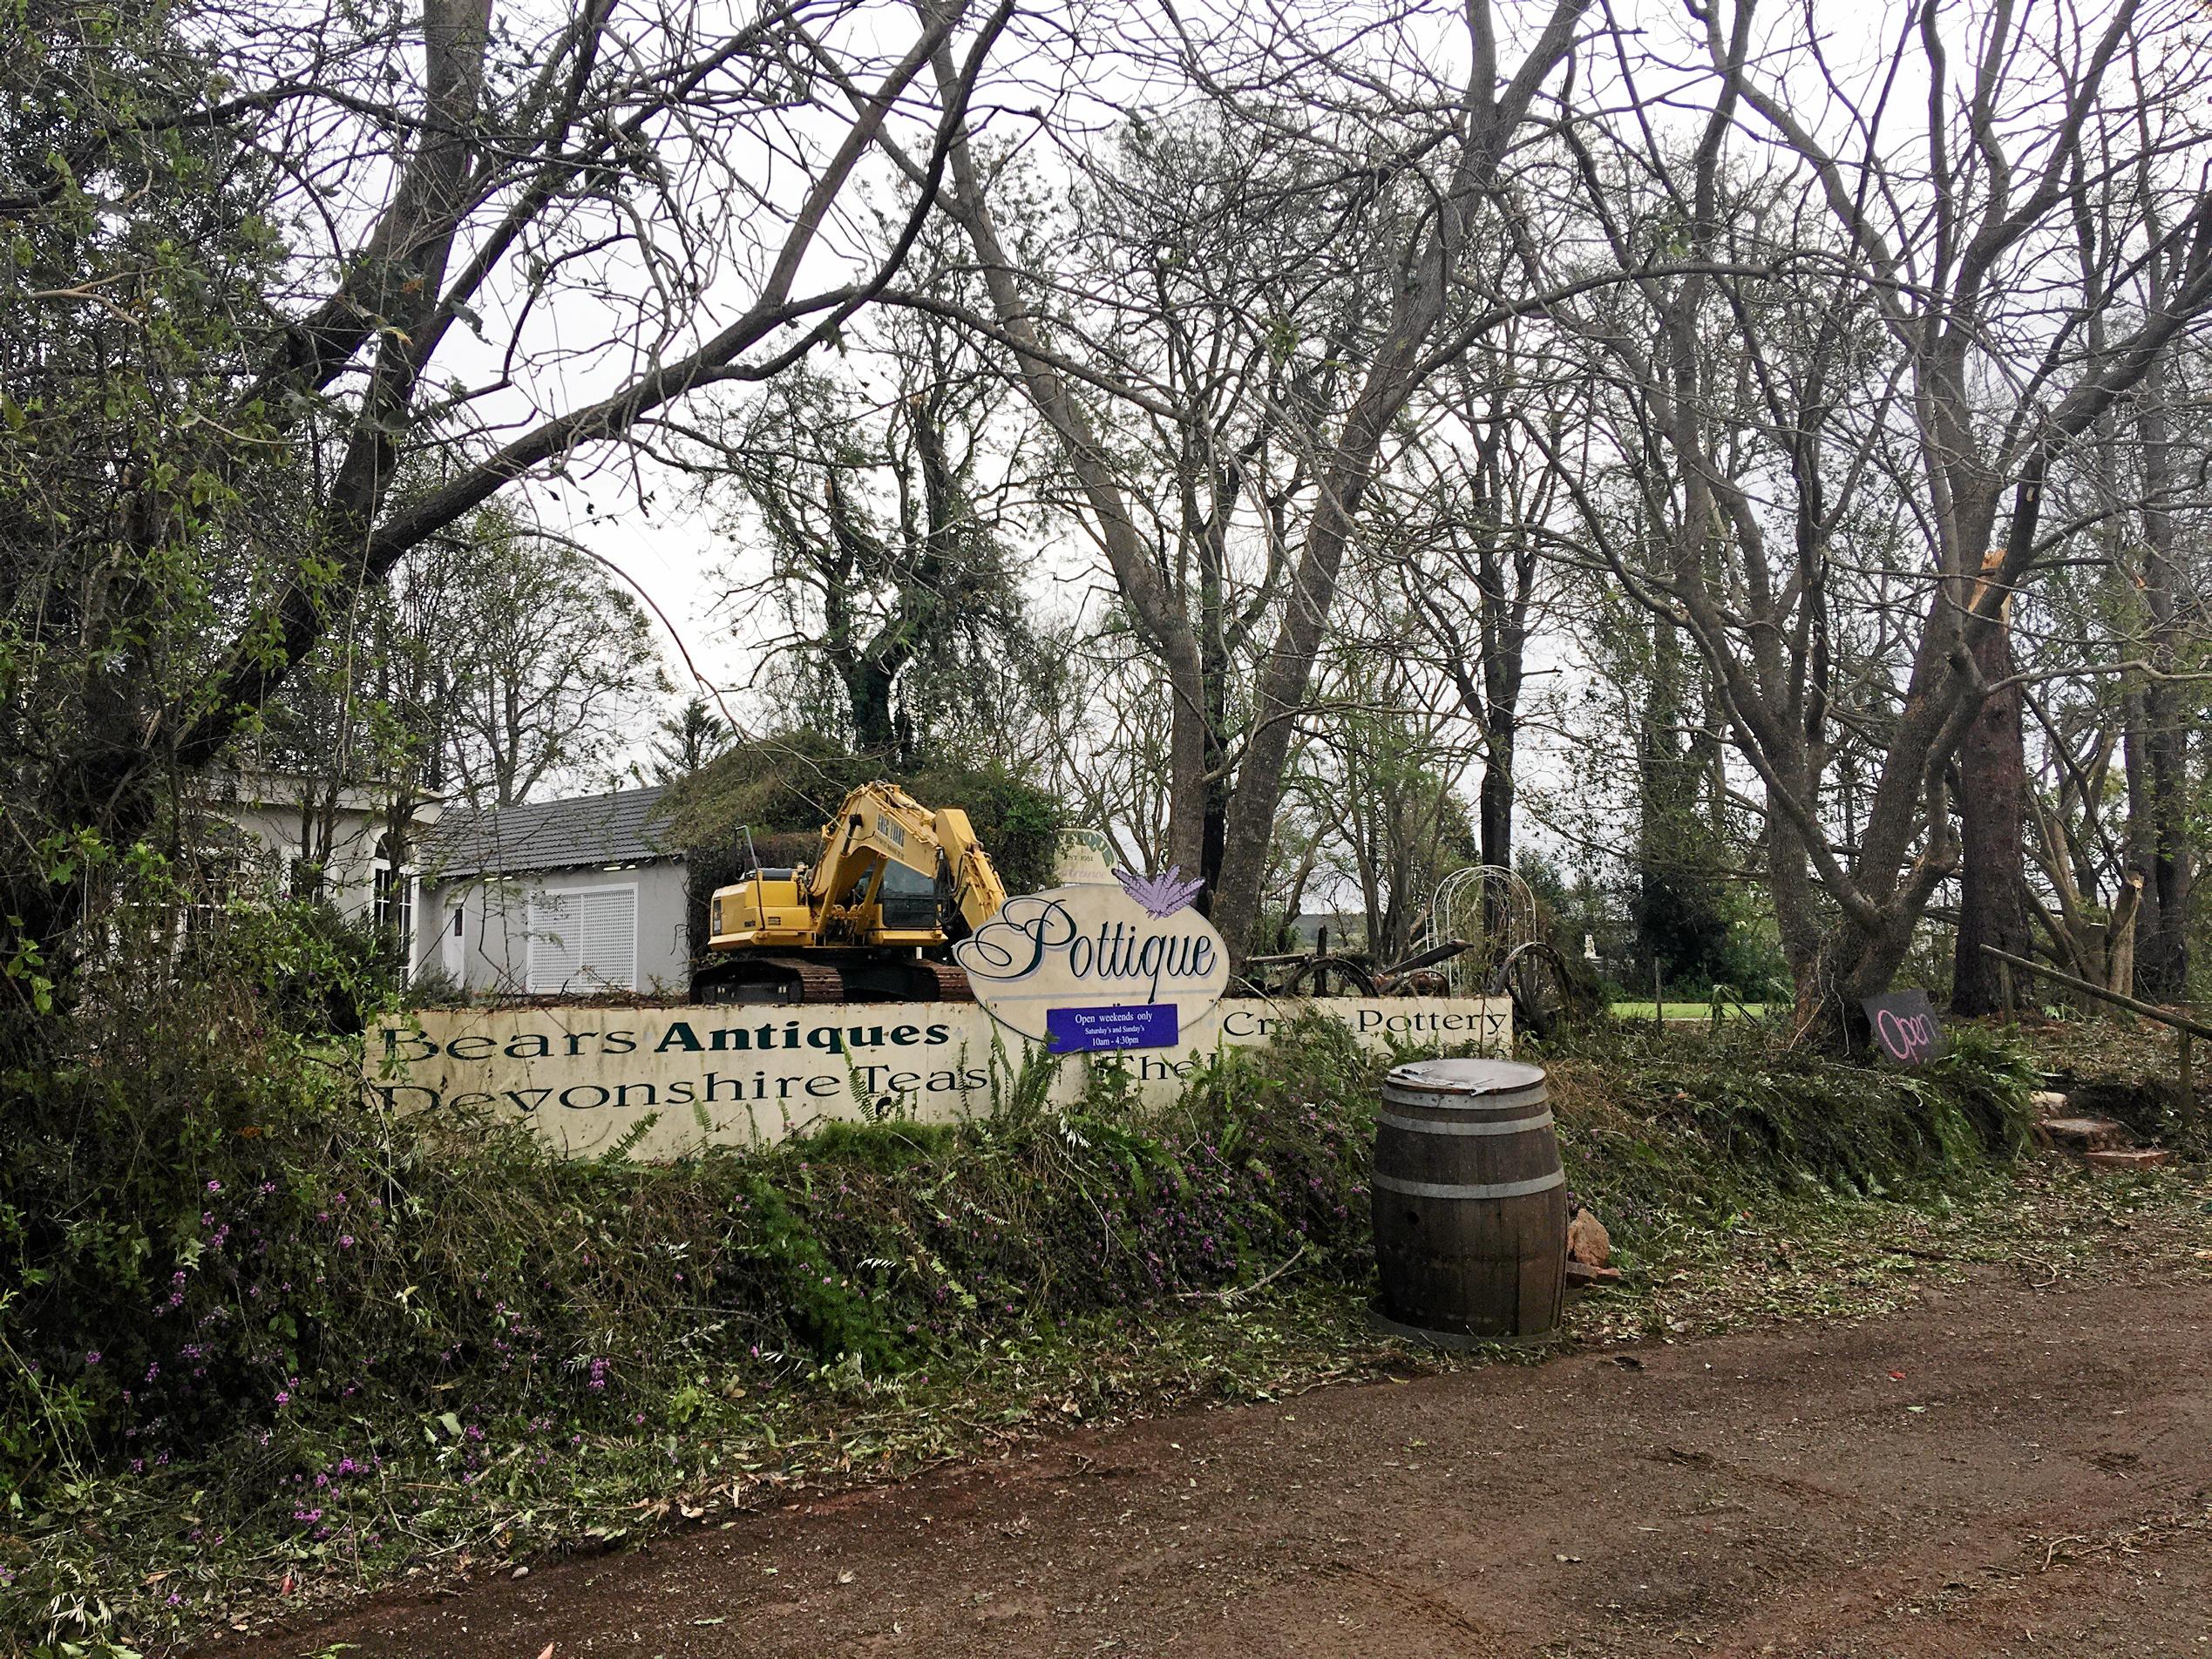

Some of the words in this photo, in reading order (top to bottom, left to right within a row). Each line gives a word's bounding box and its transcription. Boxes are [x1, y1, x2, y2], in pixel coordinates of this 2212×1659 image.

[958, 897, 1216, 1005] Pottique
[1075, 1013, 1096, 1026] Open
[1099, 1012, 1134, 1023] weekends
[1137, 1010, 1153, 1022] only
[1084, 1026, 1111, 1035] Saturday's
[1112, 1026, 1122, 1034] and
[1122, 1025, 1145, 1034] Sunday's
[1357, 1009, 1507, 1035] Pottery
[377, 1028, 637, 1062] Bears
[654, 1020, 950, 1055] Antiques
[1092, 1038, 1110, 1046] 10am
[1115, 1036, 1139, 1046] 4:30pm
[1877, 1009, 1937, 1065] Open
[375, 1071, 840, 1118] Devonshire
[854, 1064, 987, 1094] Teas
